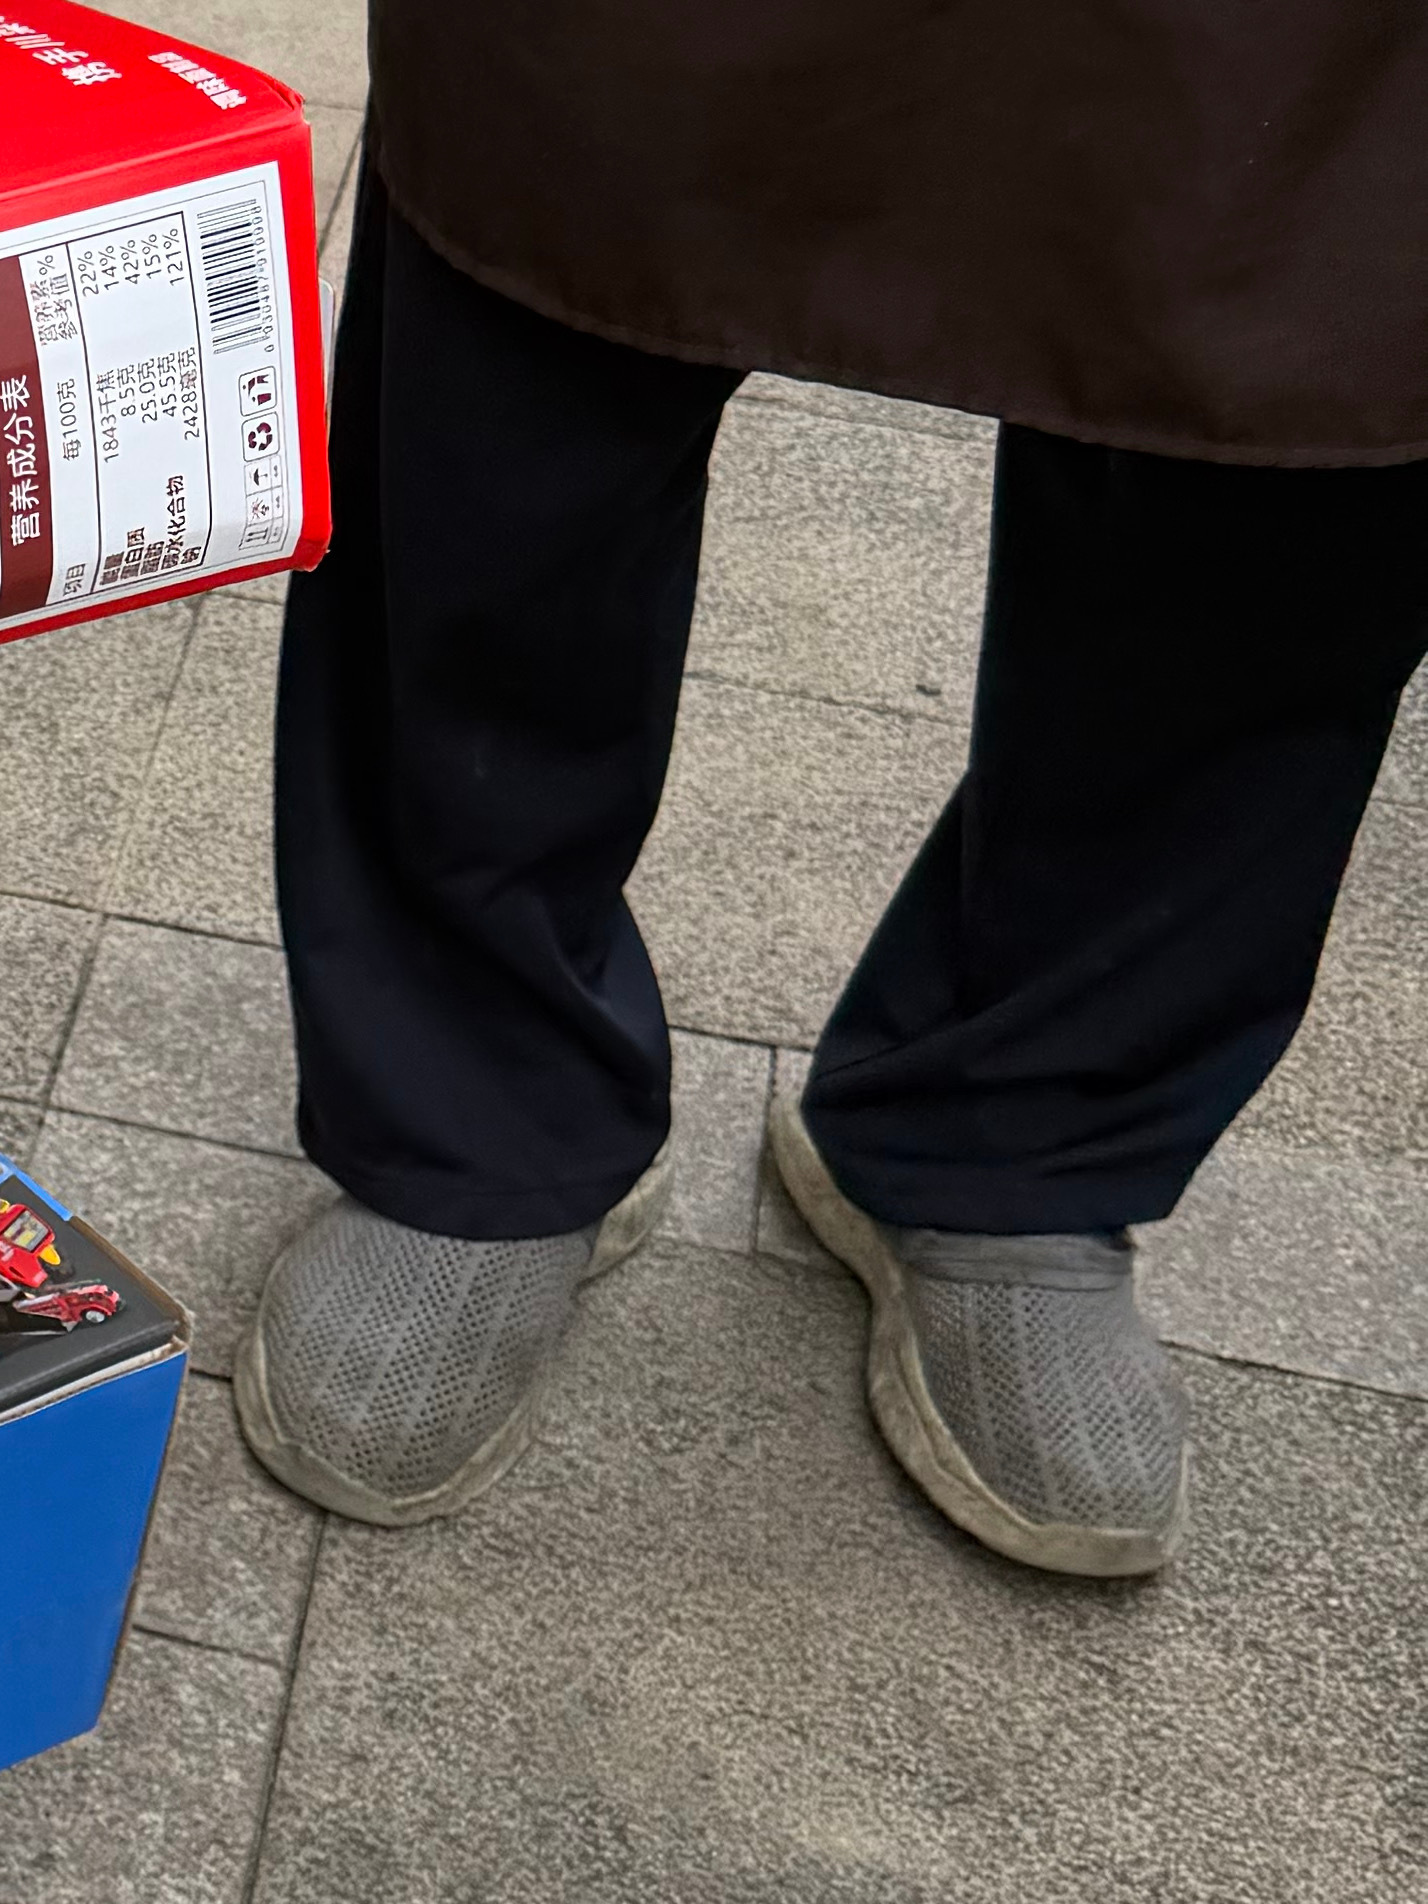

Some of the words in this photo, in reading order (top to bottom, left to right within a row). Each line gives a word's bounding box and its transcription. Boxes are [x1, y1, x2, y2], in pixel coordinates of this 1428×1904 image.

[37, 253, 54, 277] %
[76, 248, 99, 298] 22%
[98, 243, 119, 291] 14%
[119, 237, 141, 287] 42%
[141, 231, 162, 280] 15%
[162, 225, 186, 287] 121%
[115, 363, 137, 417] 8.5克
[136, 356, 160, 424] 25.0克
[156, 351, 180, 418] 45.5克
[176, 345, 201, 440] 2428毫克
[56, 376, 81, 462] 每100克
[96, 368, 120, 463] 1843千焦
[62, 563, 84, 596] 项目
